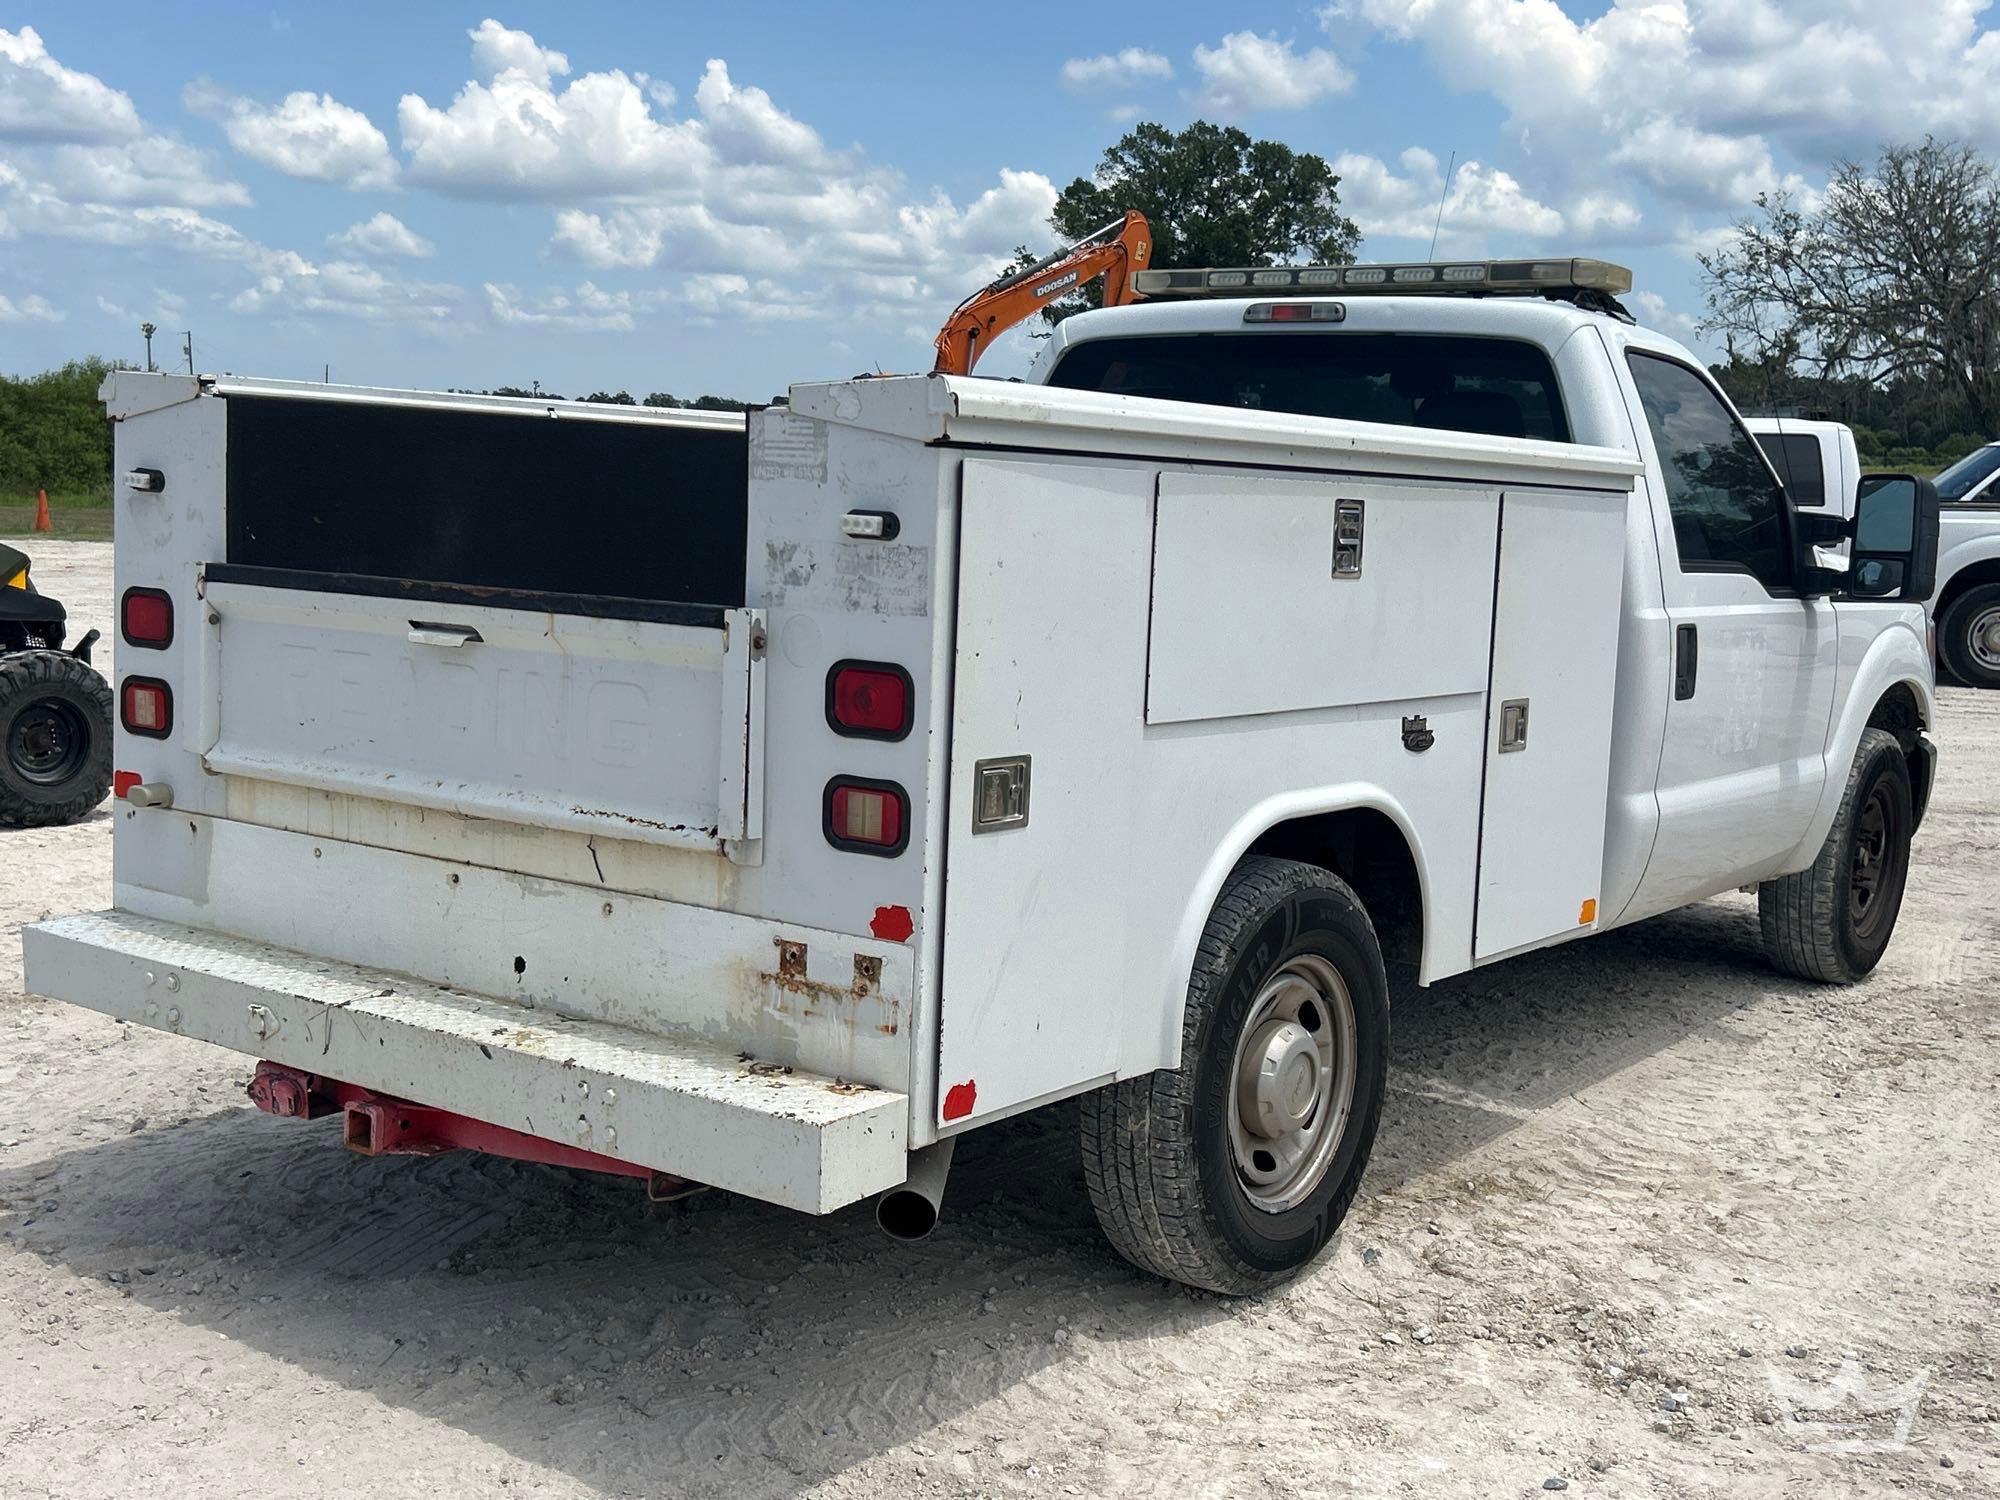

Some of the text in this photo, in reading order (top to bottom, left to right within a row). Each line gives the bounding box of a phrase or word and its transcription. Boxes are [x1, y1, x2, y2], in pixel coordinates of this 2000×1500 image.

[1036, 272, 1077, 297] DOOSAN
[279, 642, 652, 770] READING
[1208, 942, 1270, 1129] WRANGLER
